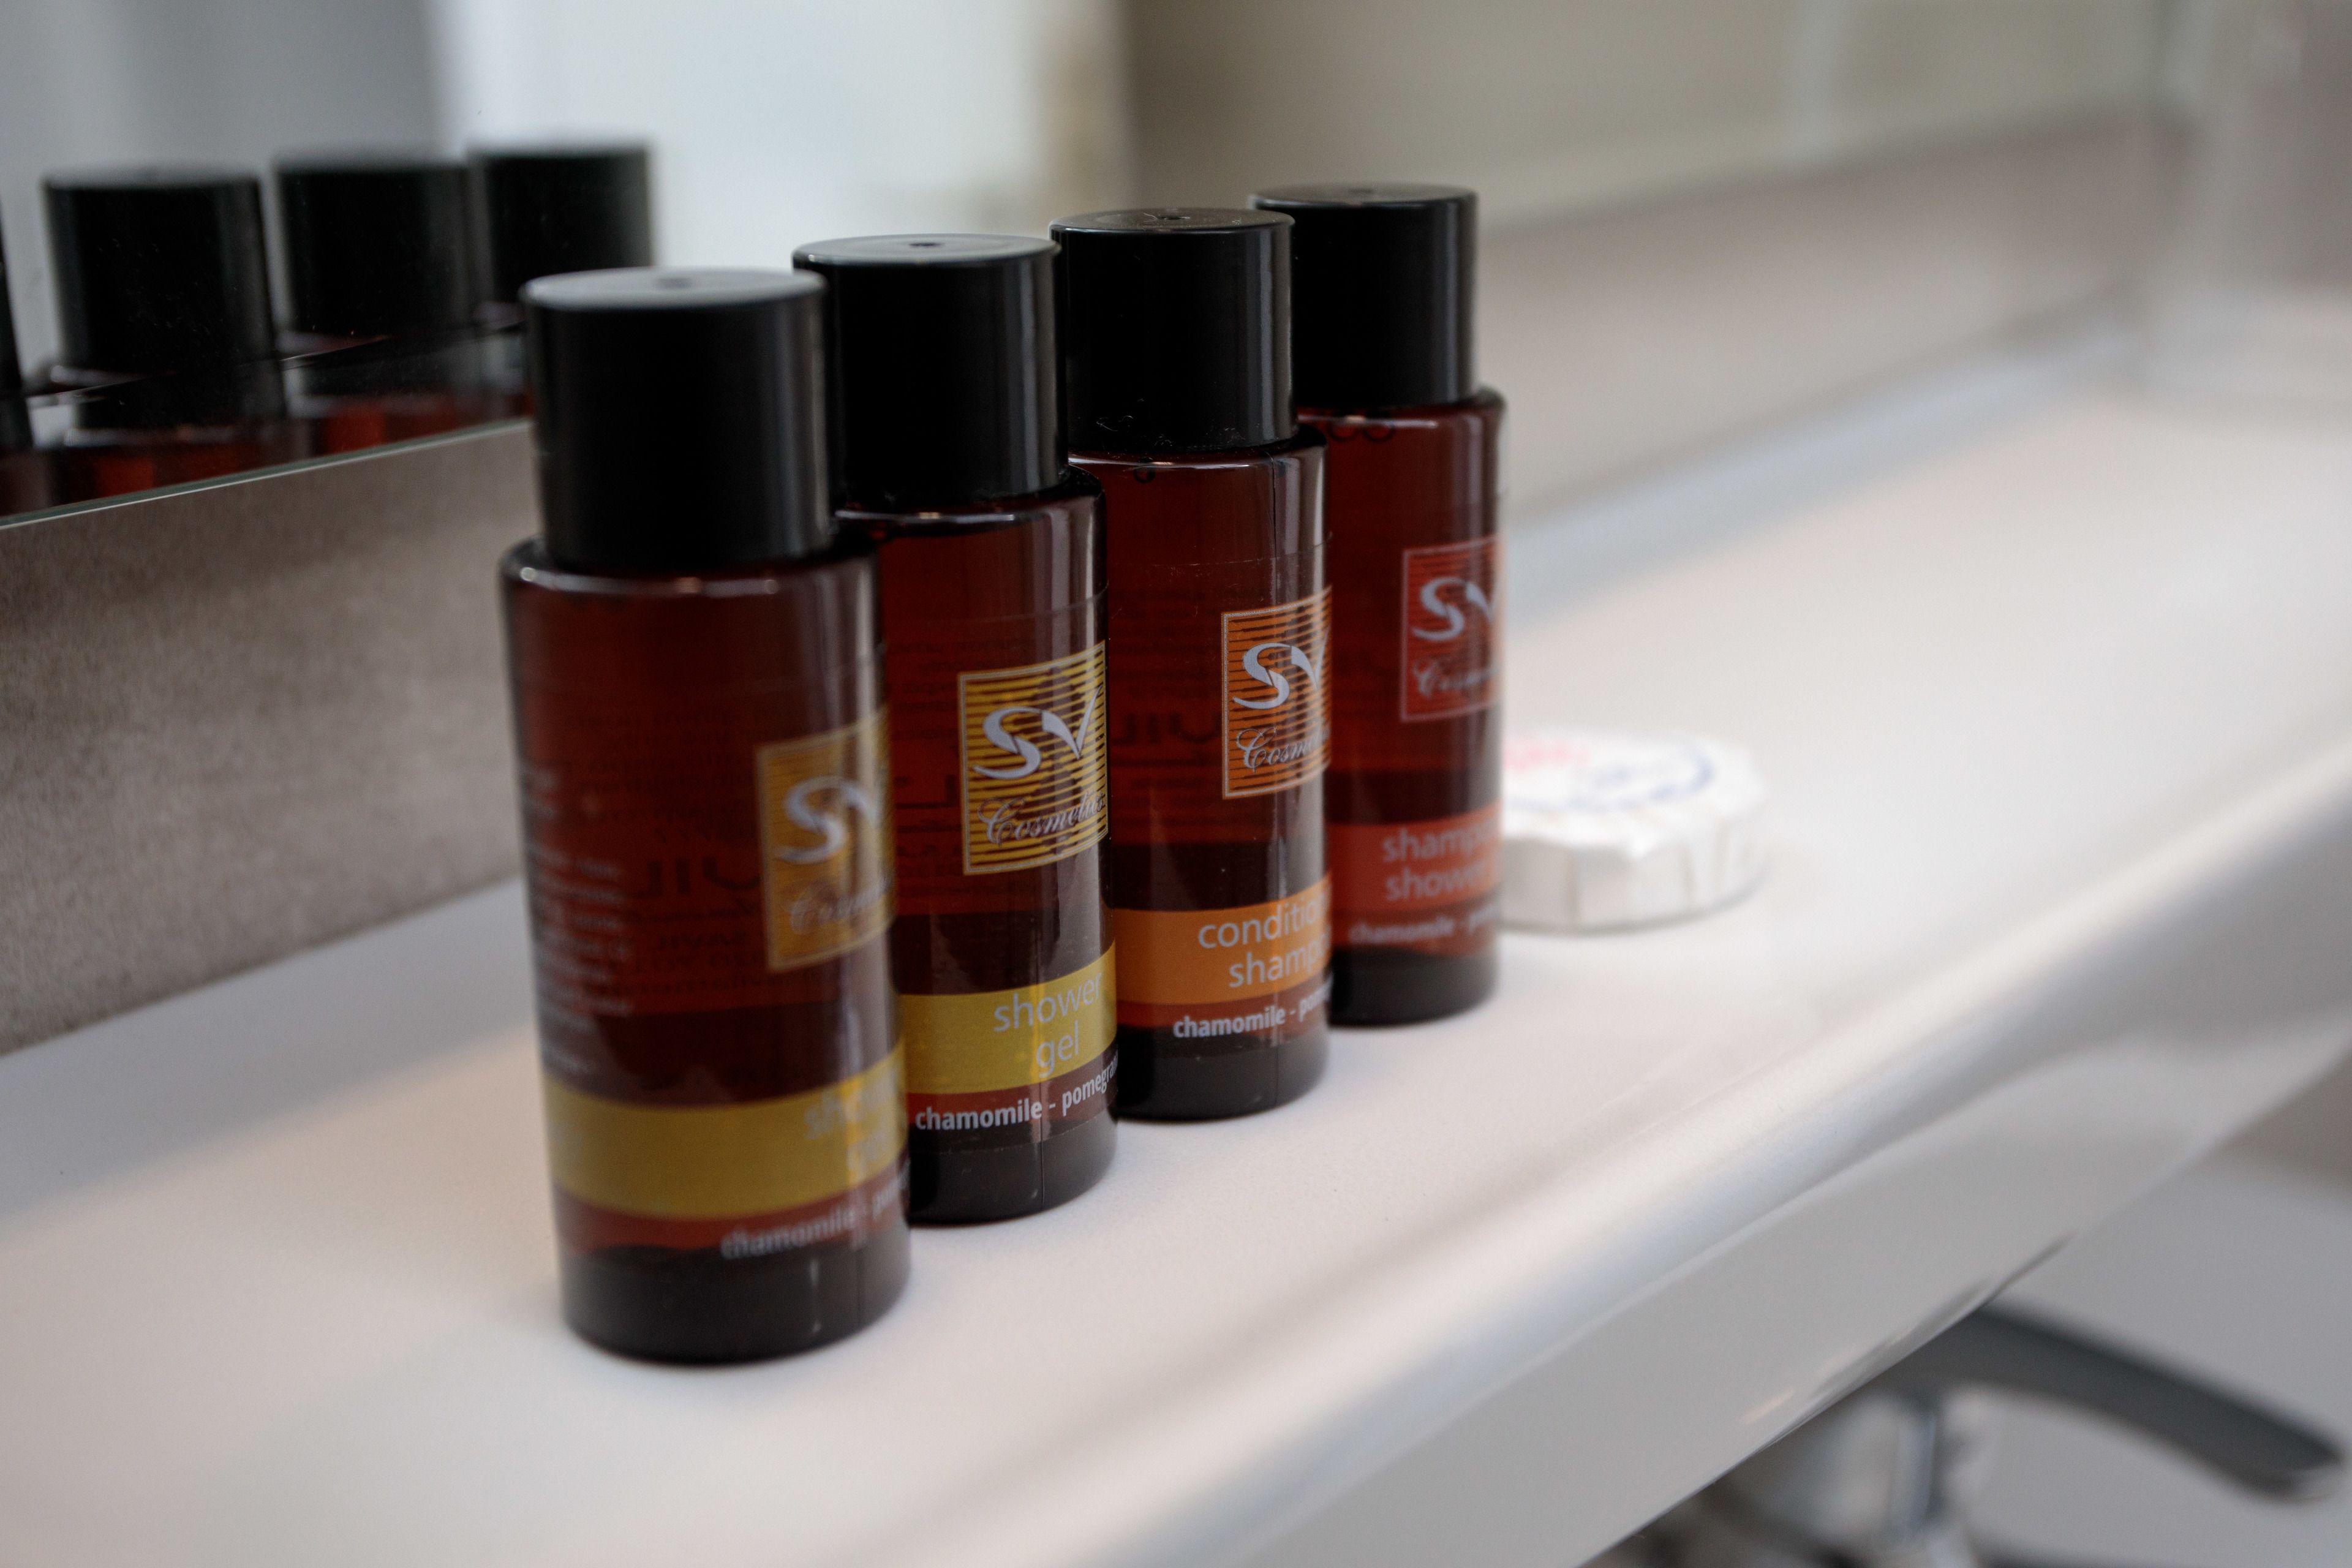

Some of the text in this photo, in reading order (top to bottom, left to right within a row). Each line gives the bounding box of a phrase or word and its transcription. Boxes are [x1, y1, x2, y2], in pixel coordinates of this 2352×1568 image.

[1232, 628, 1331, 709] SV
[973, 684, 1102, 780] SV
[993, 972, 1101, 1033] shower
[1173, 1005, 1285, 1038] chamomile
[1036, 1020, 1079, 1078] gel
[916, 1098, 1042, 1131] chamomile
